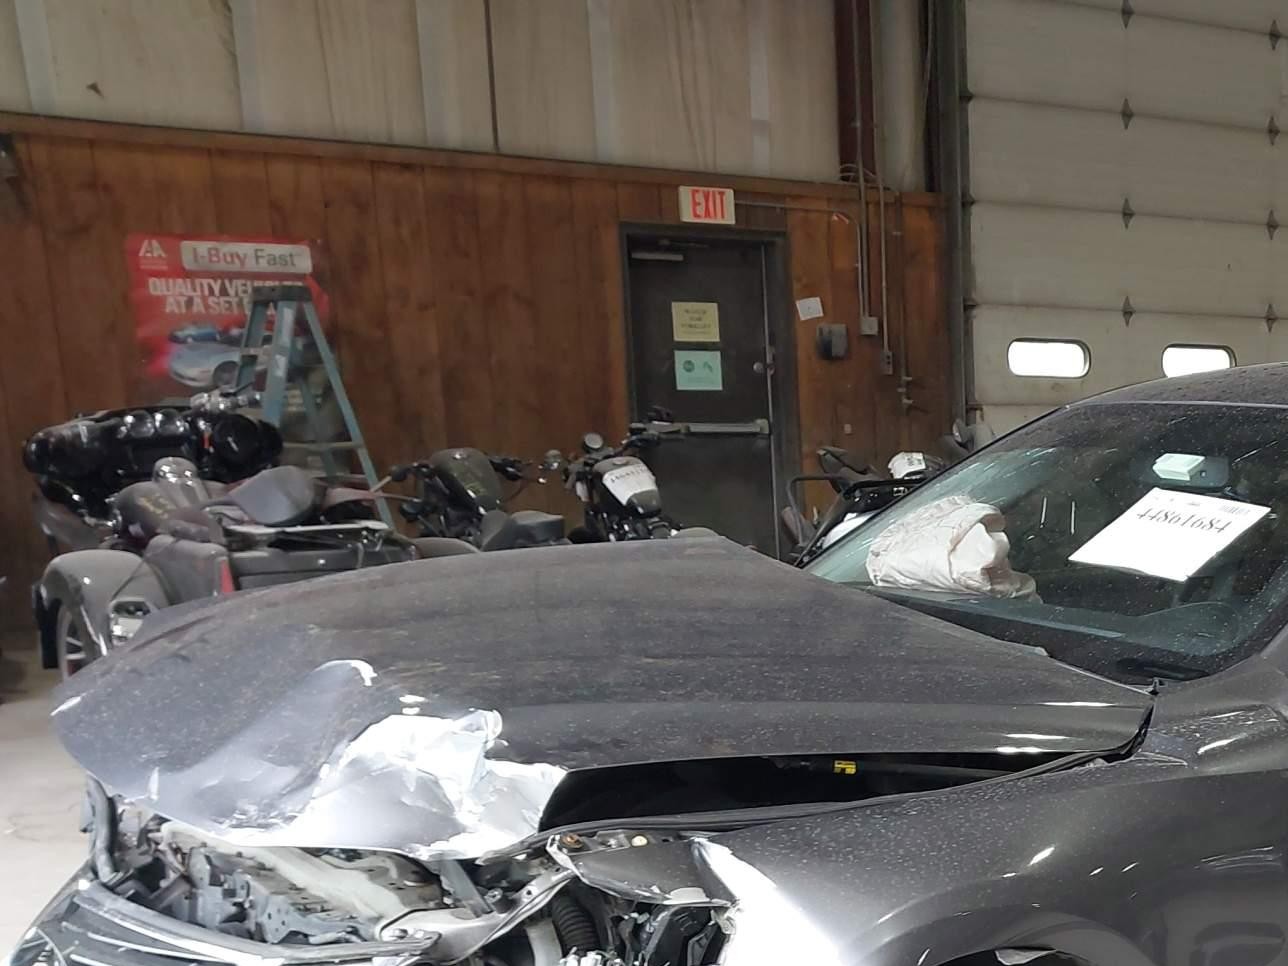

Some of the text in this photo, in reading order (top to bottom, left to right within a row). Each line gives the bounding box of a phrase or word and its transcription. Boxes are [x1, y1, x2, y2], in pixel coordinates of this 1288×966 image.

[691, 189, 726, 219] EXIT
[192, 247, 248, 268] I-Buy
[254, 248, 296, 267] Fast
[149, 277, 222, 297] QUALITY
[165, 295, 188, 314] AT
[192, 295, 206, 315] A
[208, 296, 240, 316] SET
[1137, 507, 1233, 534] 44861684
